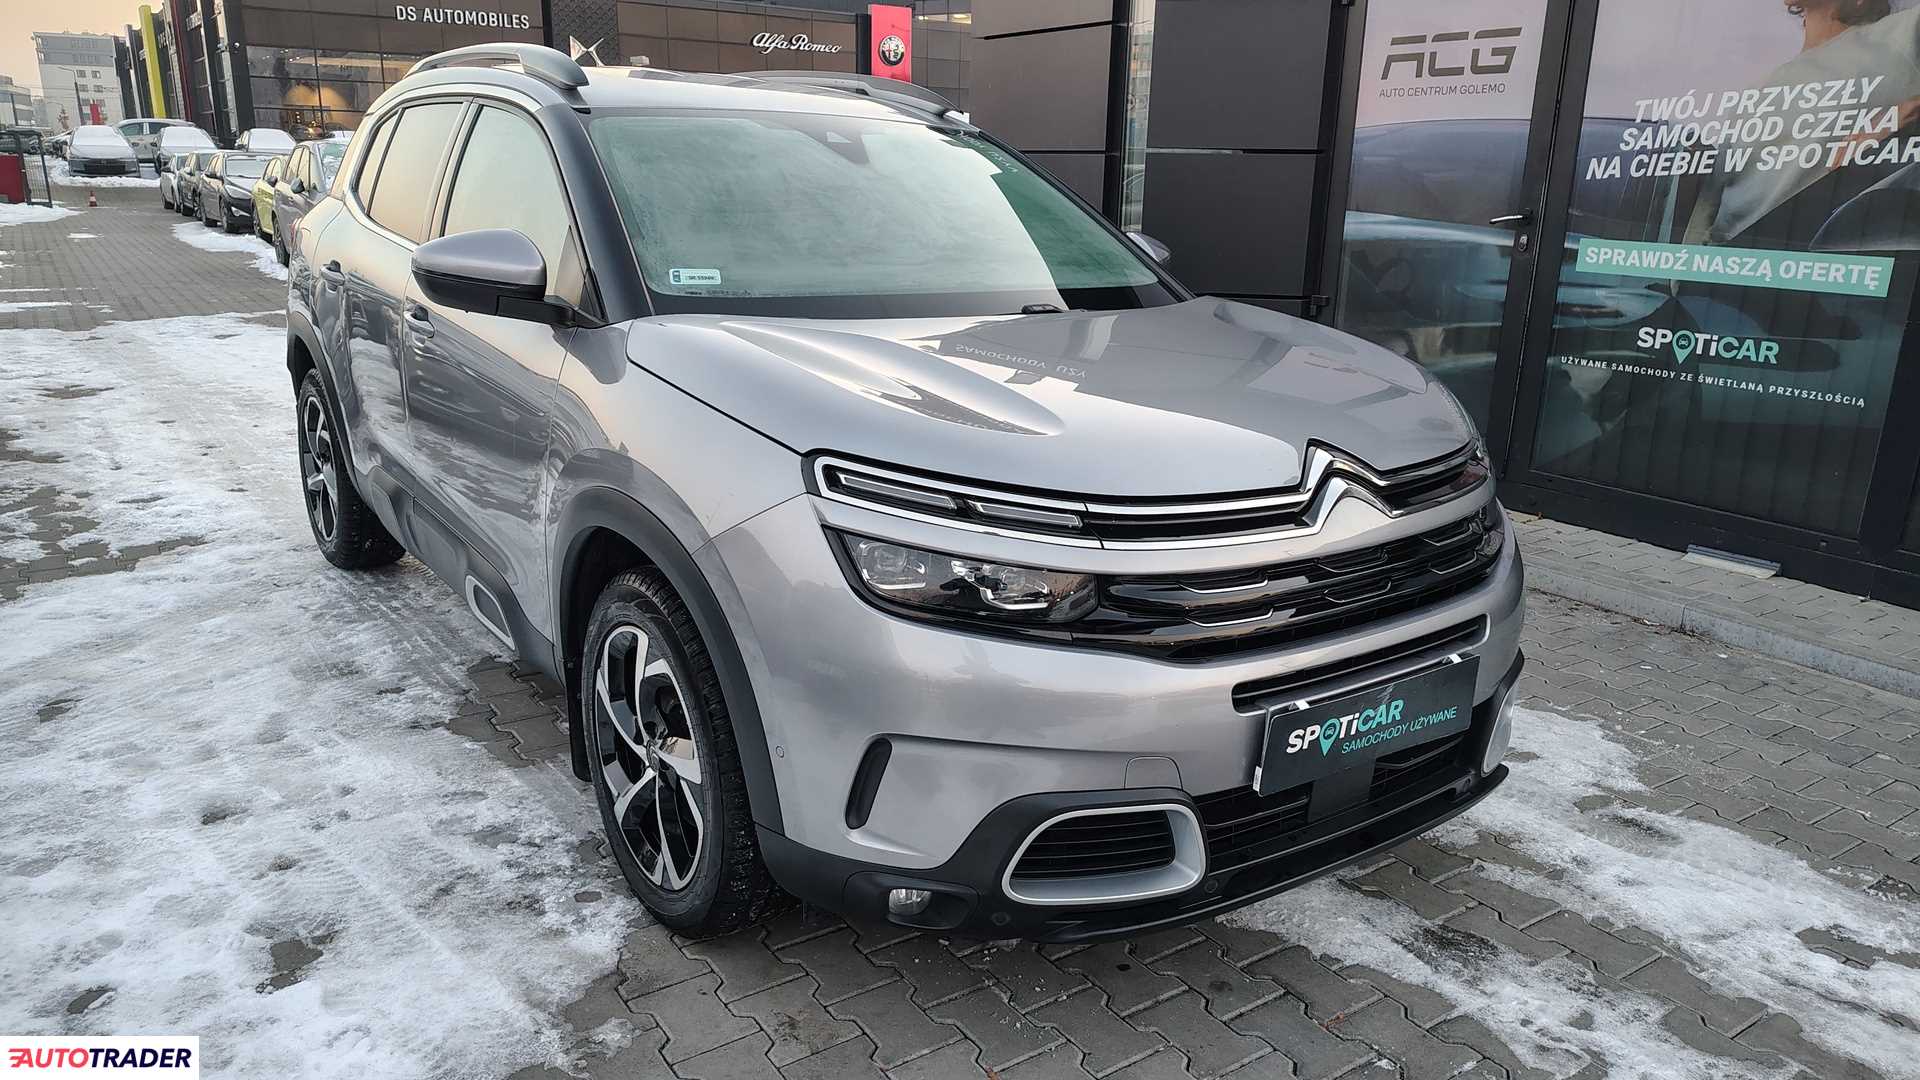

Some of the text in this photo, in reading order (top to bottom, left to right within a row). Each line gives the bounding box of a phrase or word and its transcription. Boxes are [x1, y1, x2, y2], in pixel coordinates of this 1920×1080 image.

[395, 5, 530, 29] DS AUTOMOBILES
[752, 32, 842, 54] Alfa Romeo
[1381, 26, 1522, 80] ACG
[1379, 83, 1506, 98] AUTO CENTRUM GOLEMO
[1634, 76, 1884, 123] TWÓJ PRZYSZŁY
[1619, 105, 1899, 151] SAMOCHÓD CZEKA
[1585, 136, 1920, 180] NA CIEBIE W SPOTICAR
[1585, 247, 1883, 290] SPRAWDŹ NASZĄ OFERTĘ
[1561, 355, 1865, 408] UŻYWANE SAMOCHODY ZE ŚWIETLANĄ PRZYSZŁOŚCIĄ
[1341, 706, 1458, 754] SAMOCHODY UŻYWANE
